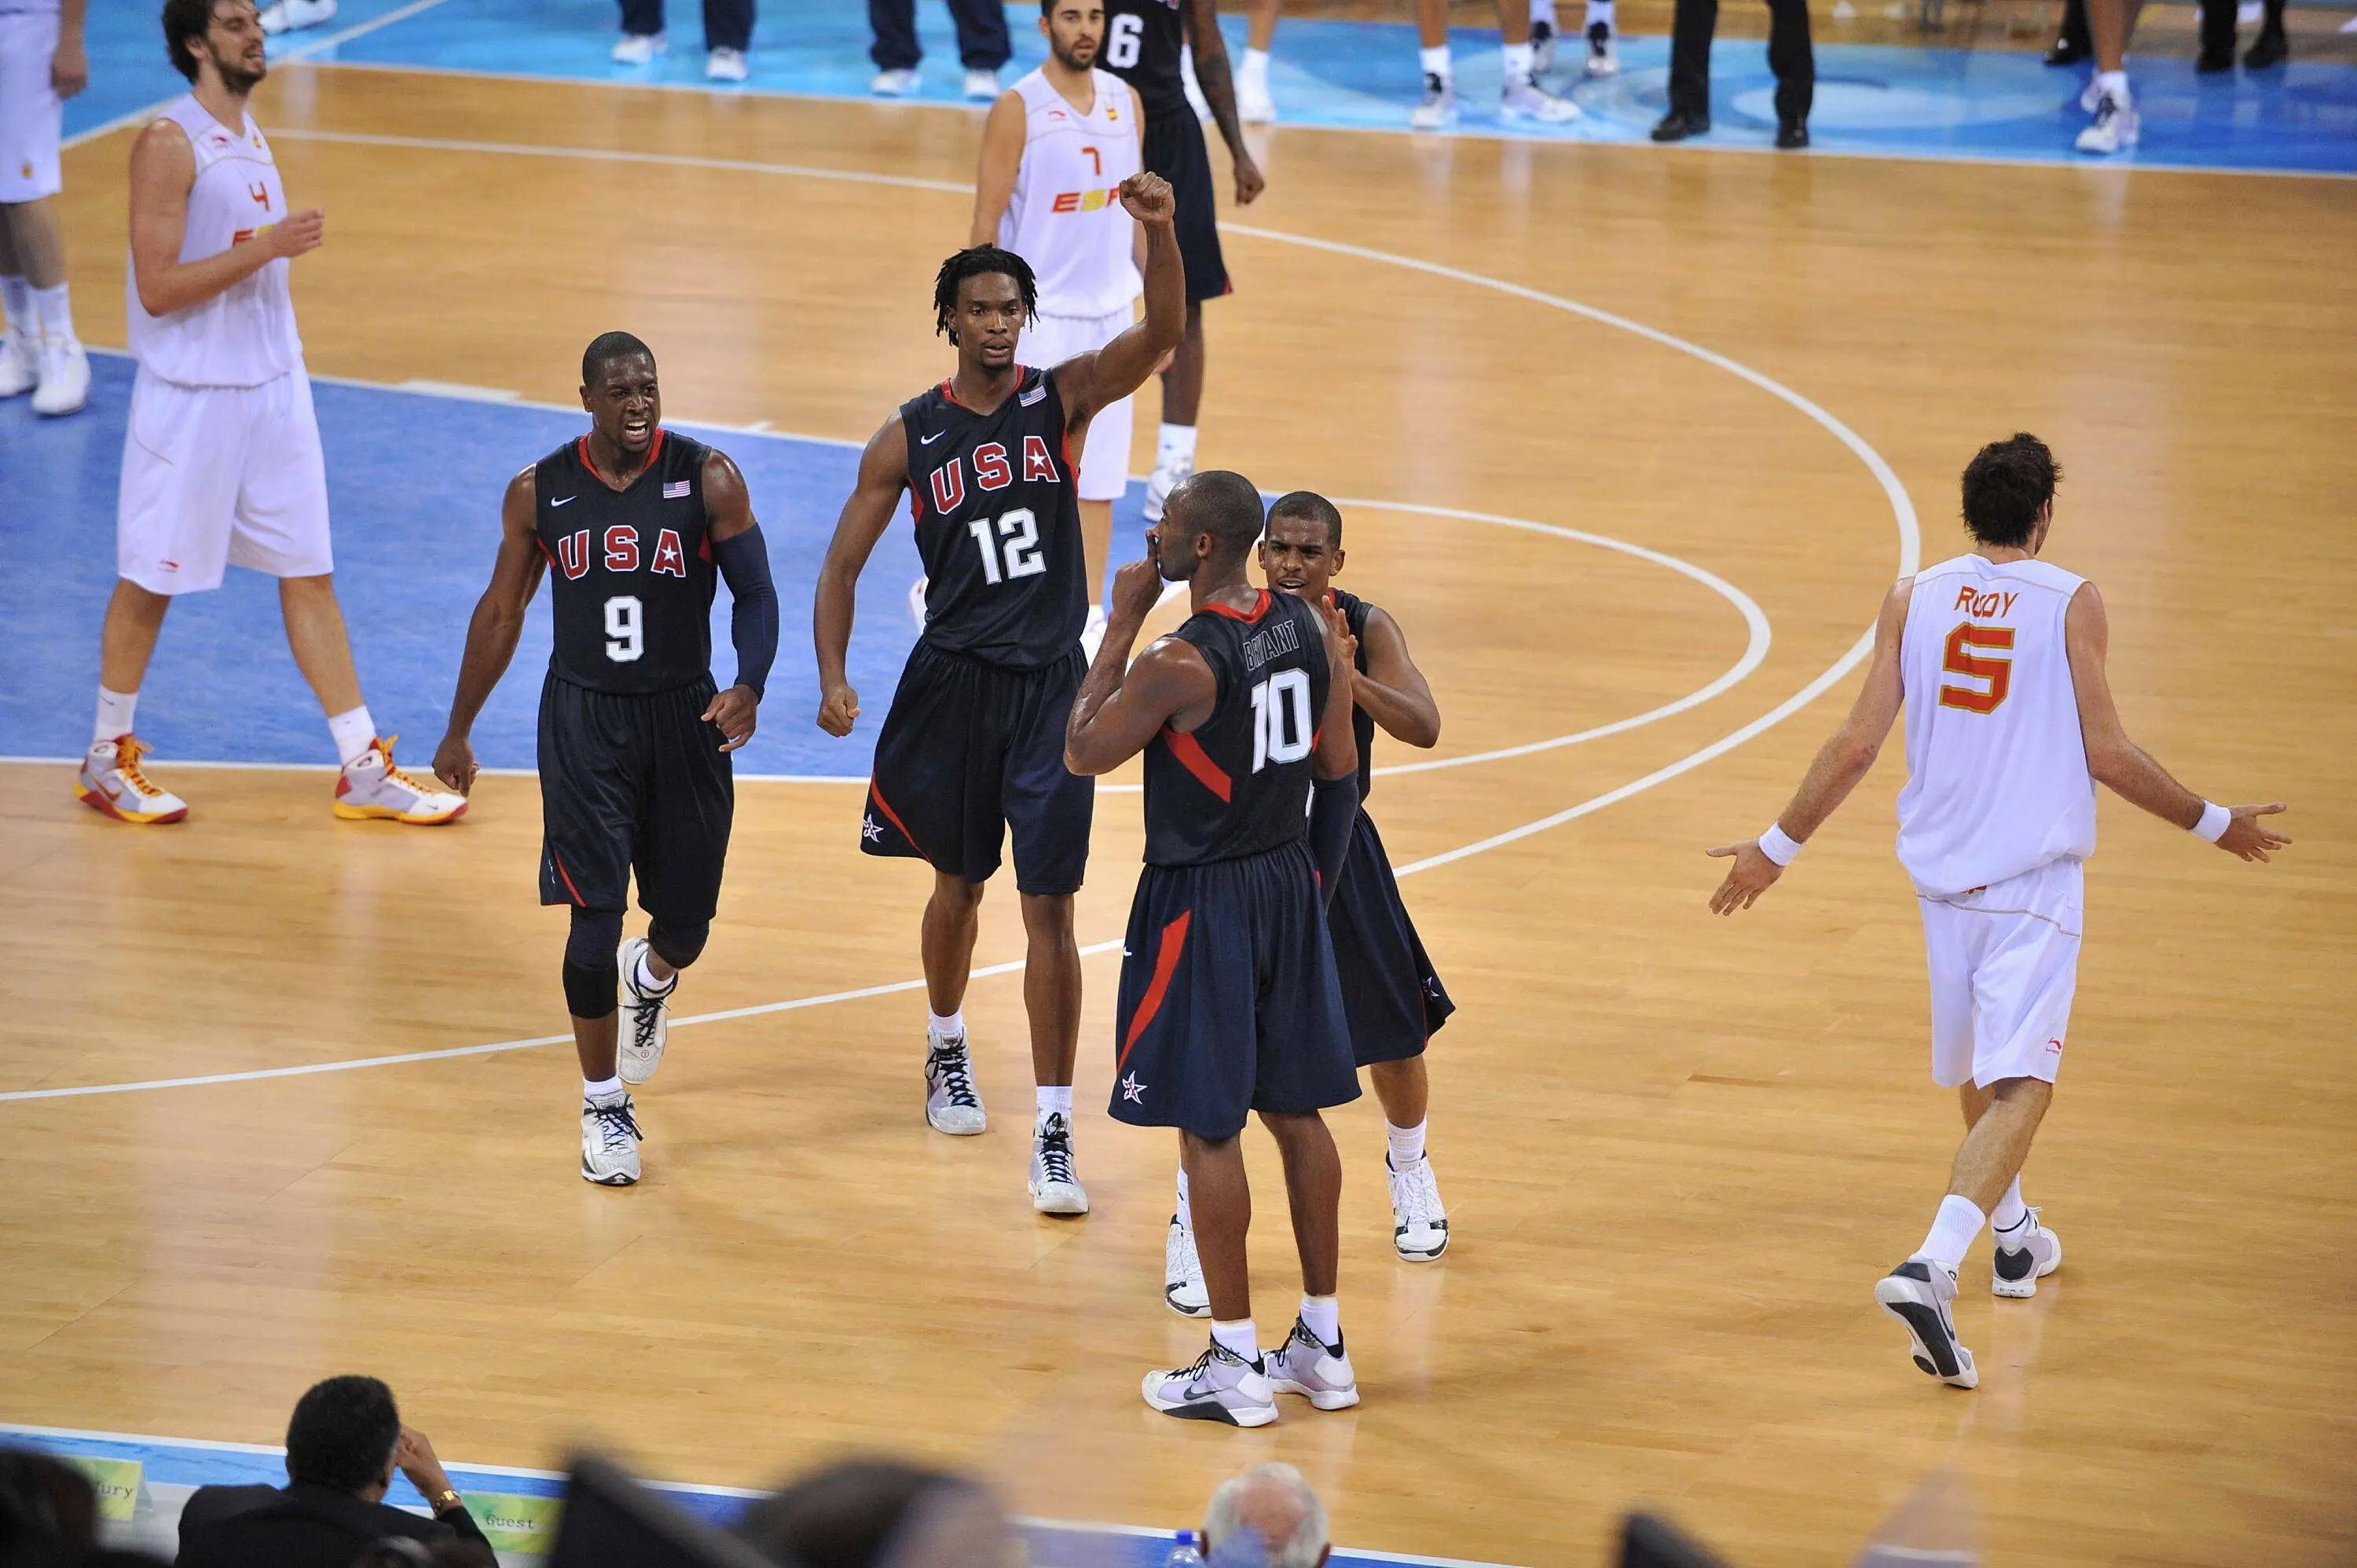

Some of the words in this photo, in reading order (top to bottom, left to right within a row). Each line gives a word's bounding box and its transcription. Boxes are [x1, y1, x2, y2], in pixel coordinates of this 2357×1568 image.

[1106, 13, 1144, 68] 6
[1081, 146, 1102, 176] 7
[248, 181, 270, 212] 4
[930, 436, 1061, 515] USA
[559, 525, 687, 581] USA
[968, 507, 1047, 585] 12
[604, 595, 644, 663] 9
[1954, 585, 2020, 618] RUDY
[1938, 621, 2016, 715] 5
[1251, 667, 1313, 775] 10
[486, 1513, 534, 1530] Guest
